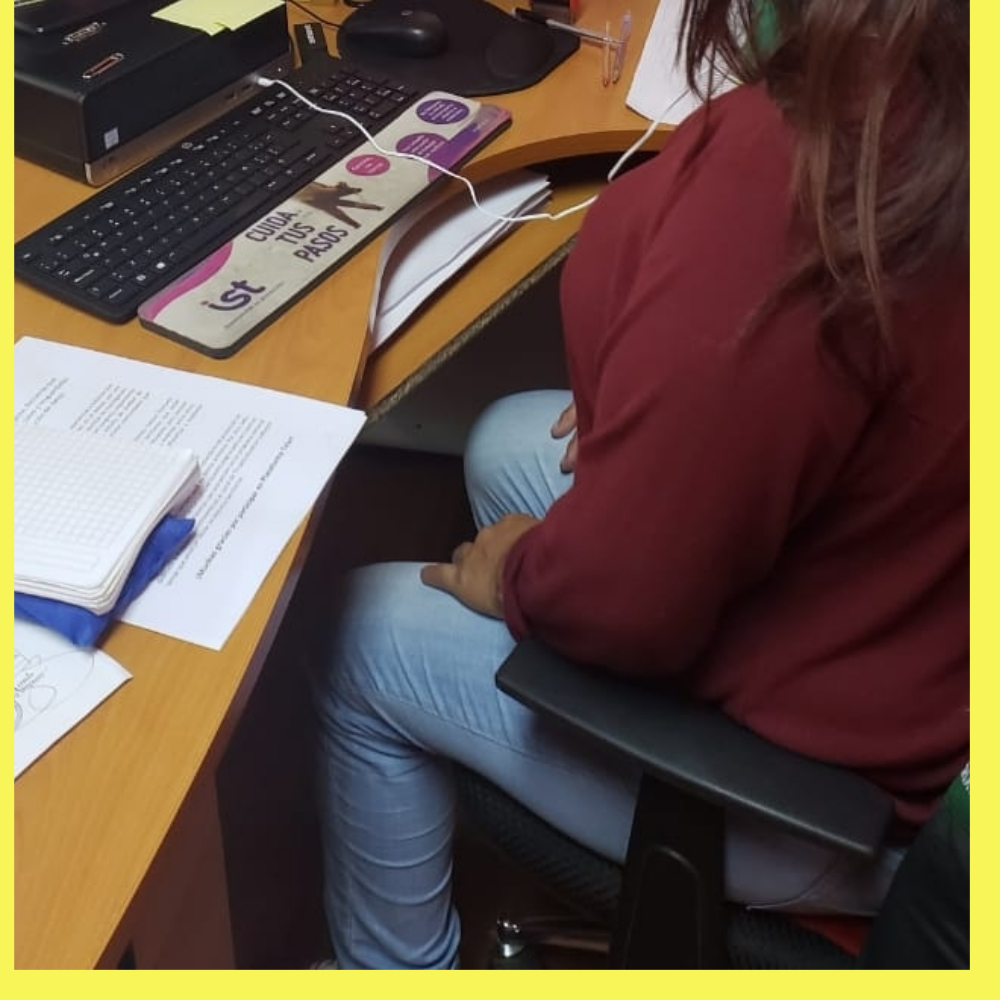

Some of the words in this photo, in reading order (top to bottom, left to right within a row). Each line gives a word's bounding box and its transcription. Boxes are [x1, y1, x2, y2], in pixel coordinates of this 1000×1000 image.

[245, 211, 299, 242] CUIDA
[274, 222, 316, 245] TUS
[293, 225, 349, 263] PASOS
[200, 280, 267, 312] ist
